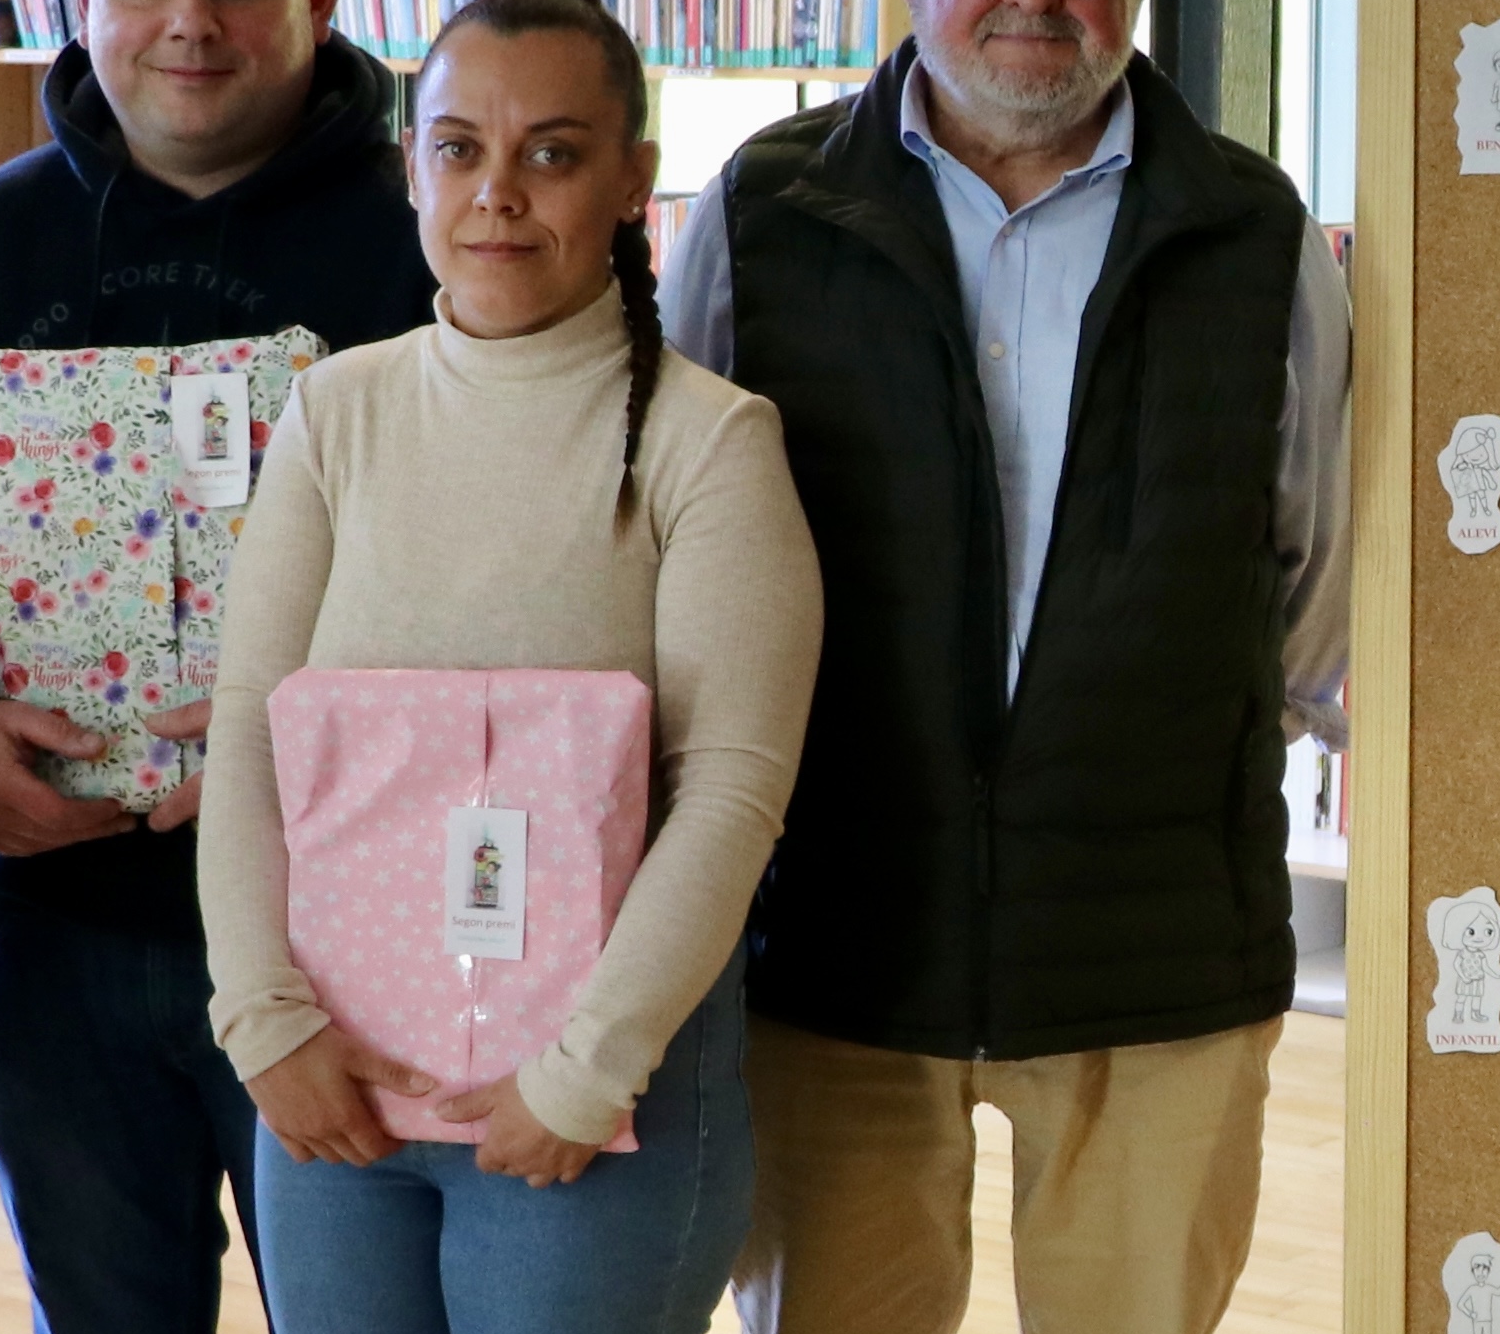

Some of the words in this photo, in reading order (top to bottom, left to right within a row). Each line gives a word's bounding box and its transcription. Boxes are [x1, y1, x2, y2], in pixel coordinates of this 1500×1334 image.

[101, 261, 181, 297] CORE
[1458, 525, 1498, 539] ALEVÍ
[452, 915, 483, 929] Segon
[486, 917, 516, 930] premi
[1436, 1034, 1500, 1046] INFANTIL
